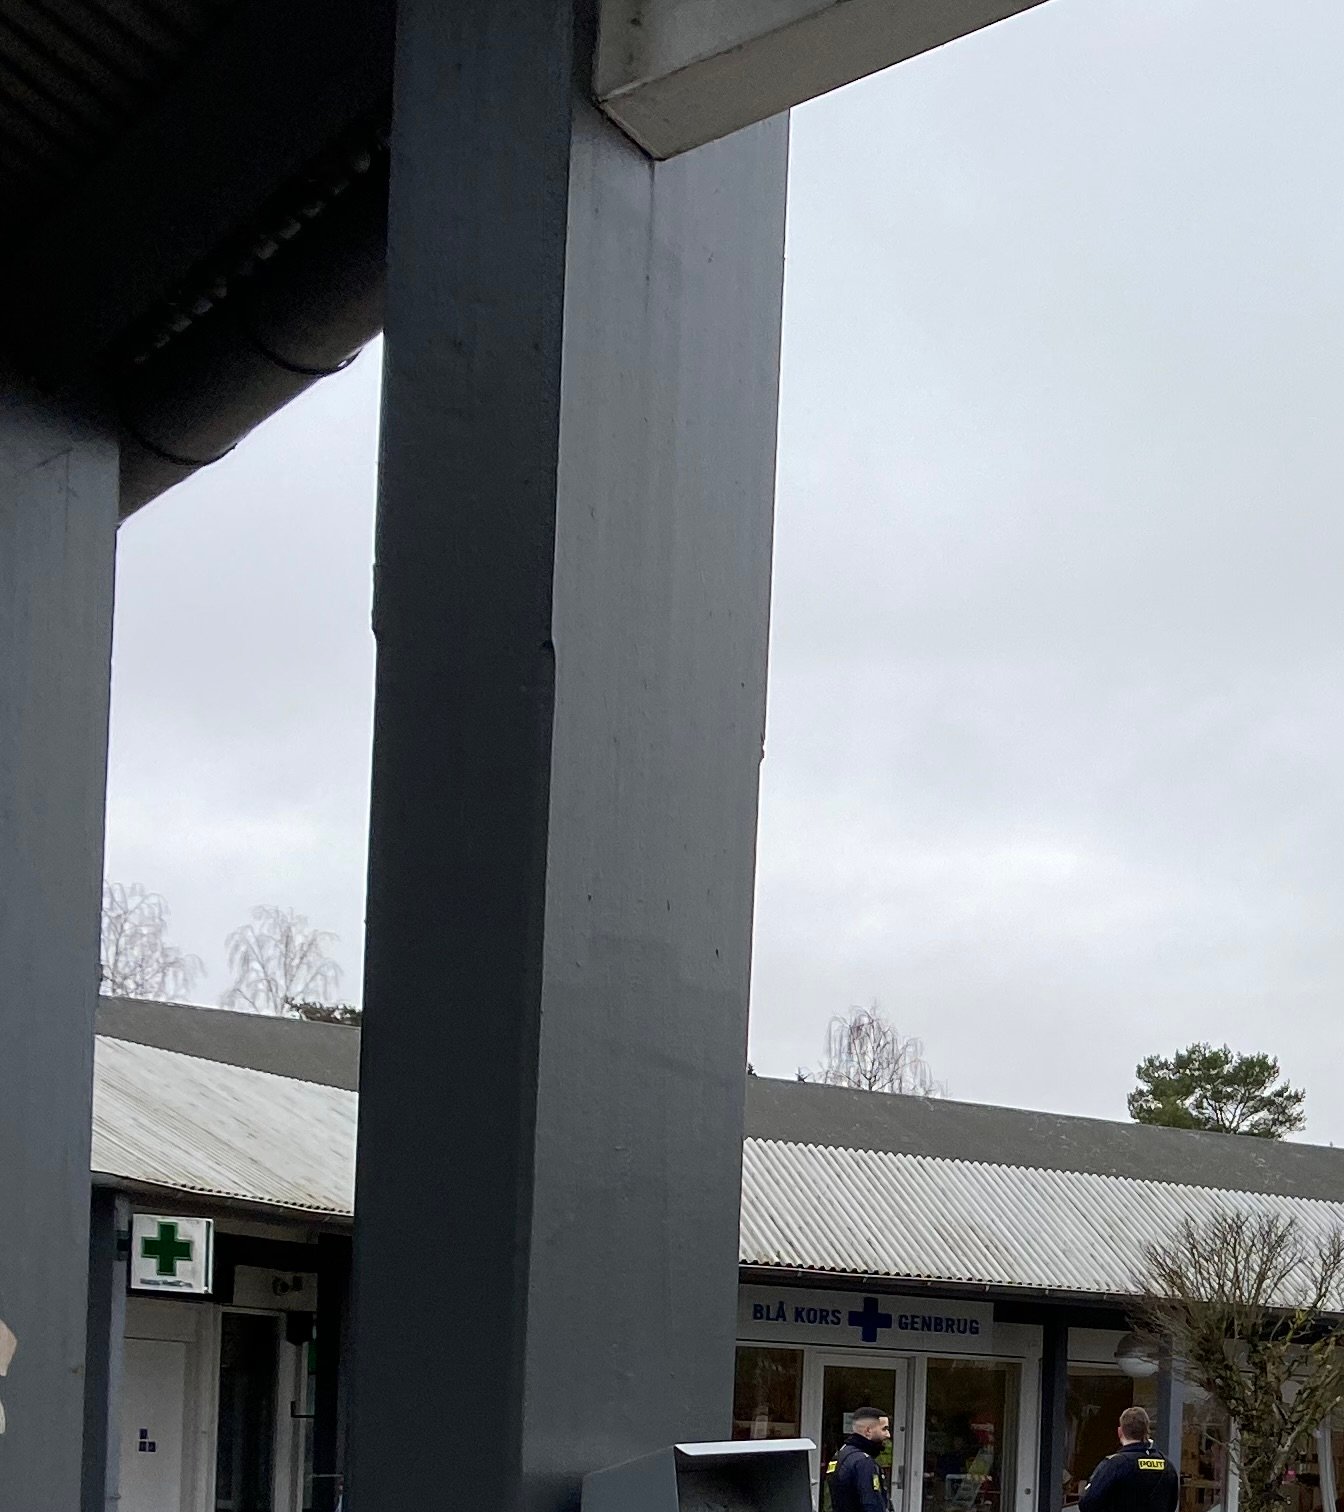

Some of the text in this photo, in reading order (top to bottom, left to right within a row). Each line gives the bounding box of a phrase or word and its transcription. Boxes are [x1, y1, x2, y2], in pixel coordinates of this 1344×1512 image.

[753, 1301, 980, 1335] BLÅ KORS GENBRUG
